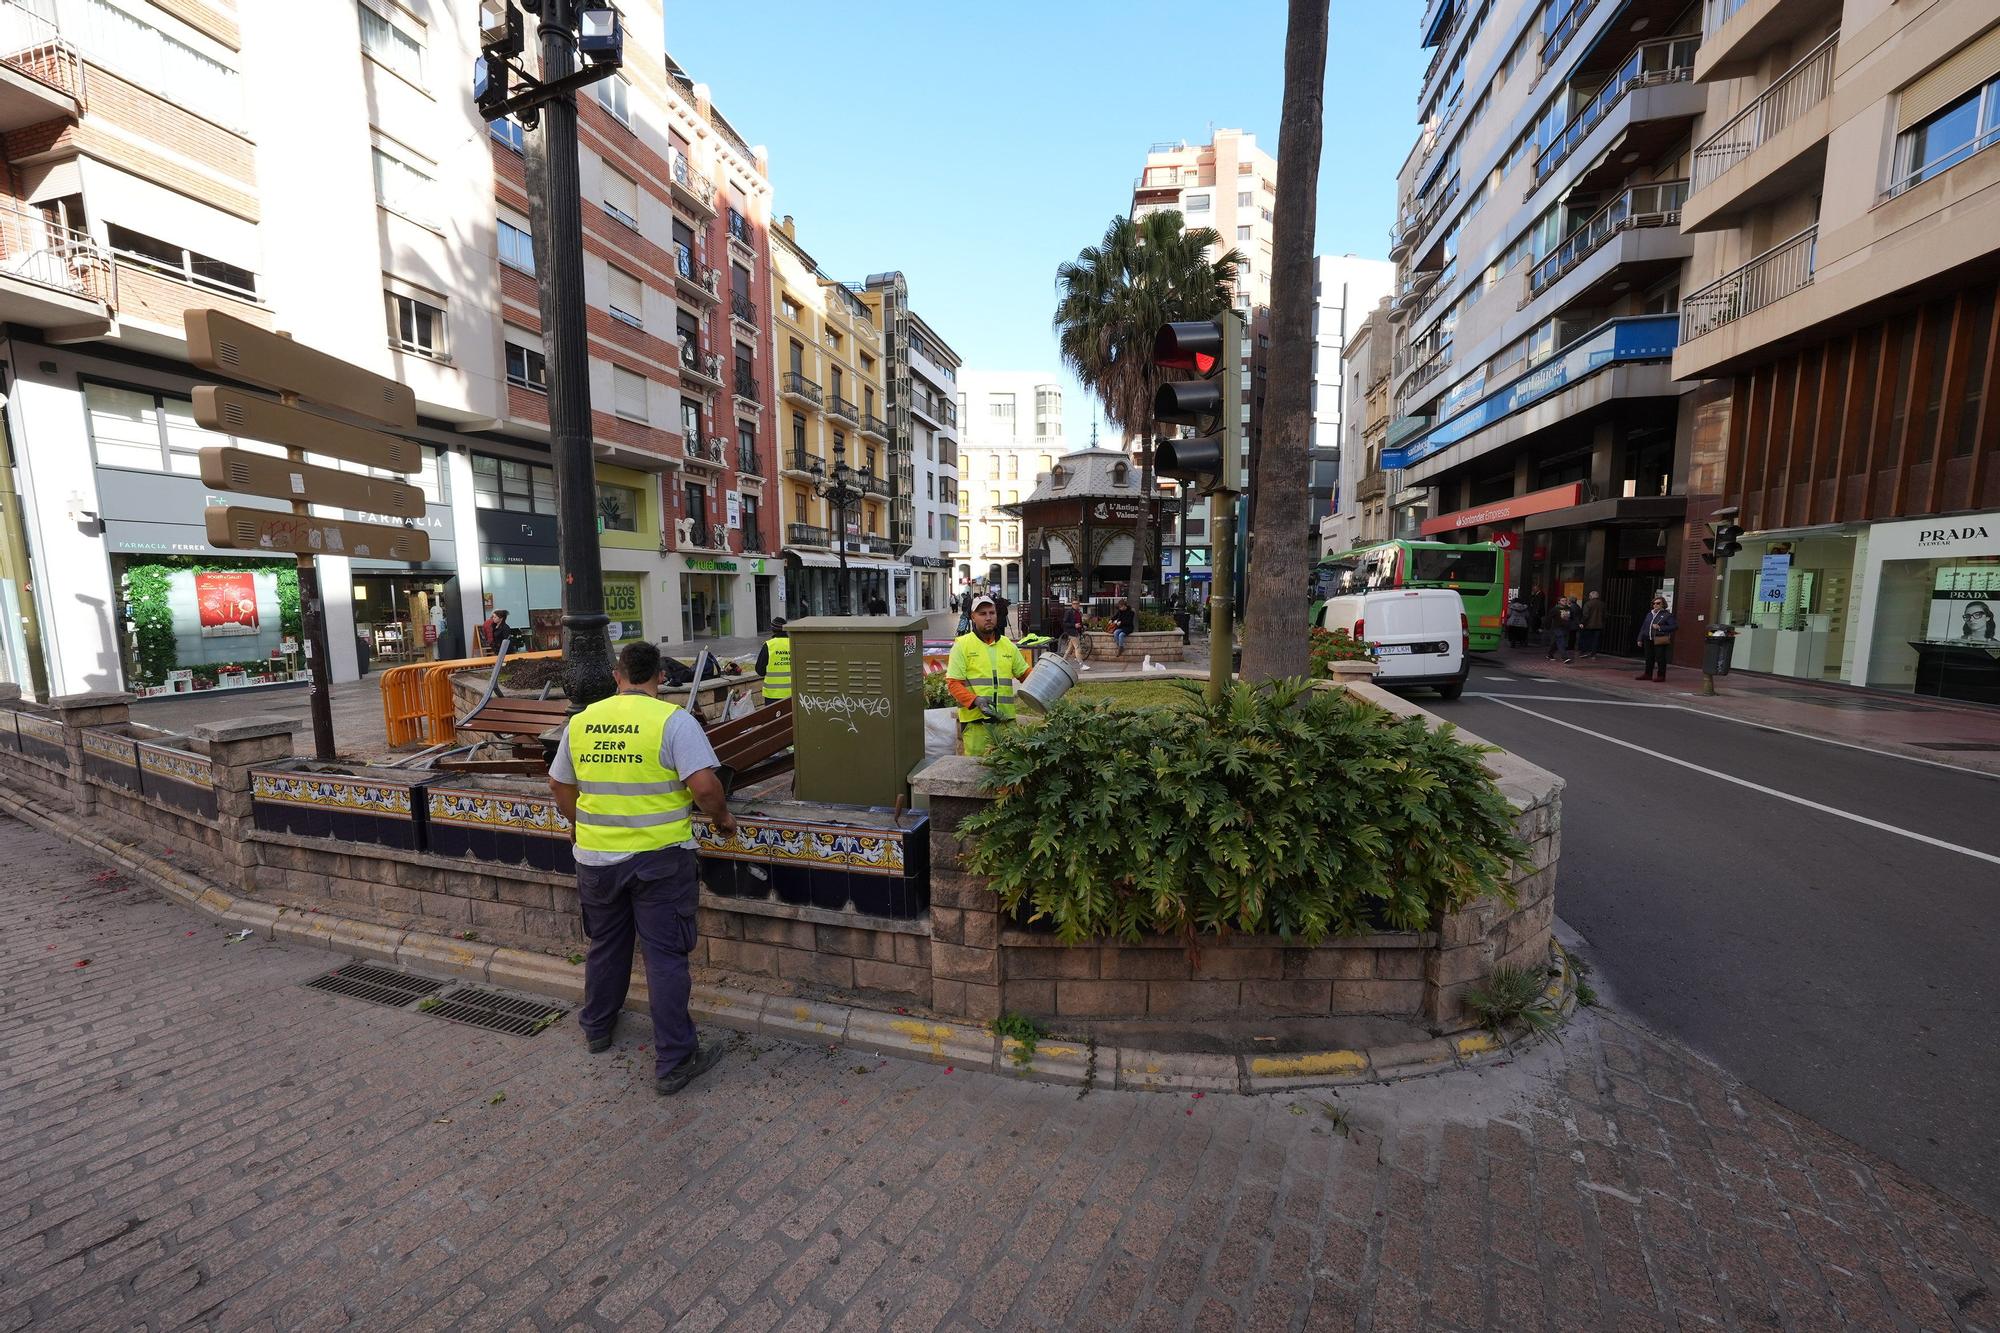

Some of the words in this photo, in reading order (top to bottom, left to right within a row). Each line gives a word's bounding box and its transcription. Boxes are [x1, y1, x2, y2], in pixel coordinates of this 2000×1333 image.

[358, 511, 442, 529] FARMACIA
[1462, 511, 1485, 527] Santander
[1920, 527, 1989, 541] PRADA
[119, 541, 168, 550] FARMACIA
[171, 543, 205, 552] FERRER
[603, 586, 636, 597] LAZOS
[1950, 591, 1989, 599] PRADA
[606, 596, 637, 610] IJOS
[585, 724, 640, 734] PAVASAL
[593, 741, 626, 750] ZERO
[580, 753, 643, 764] ACCIDENTS
